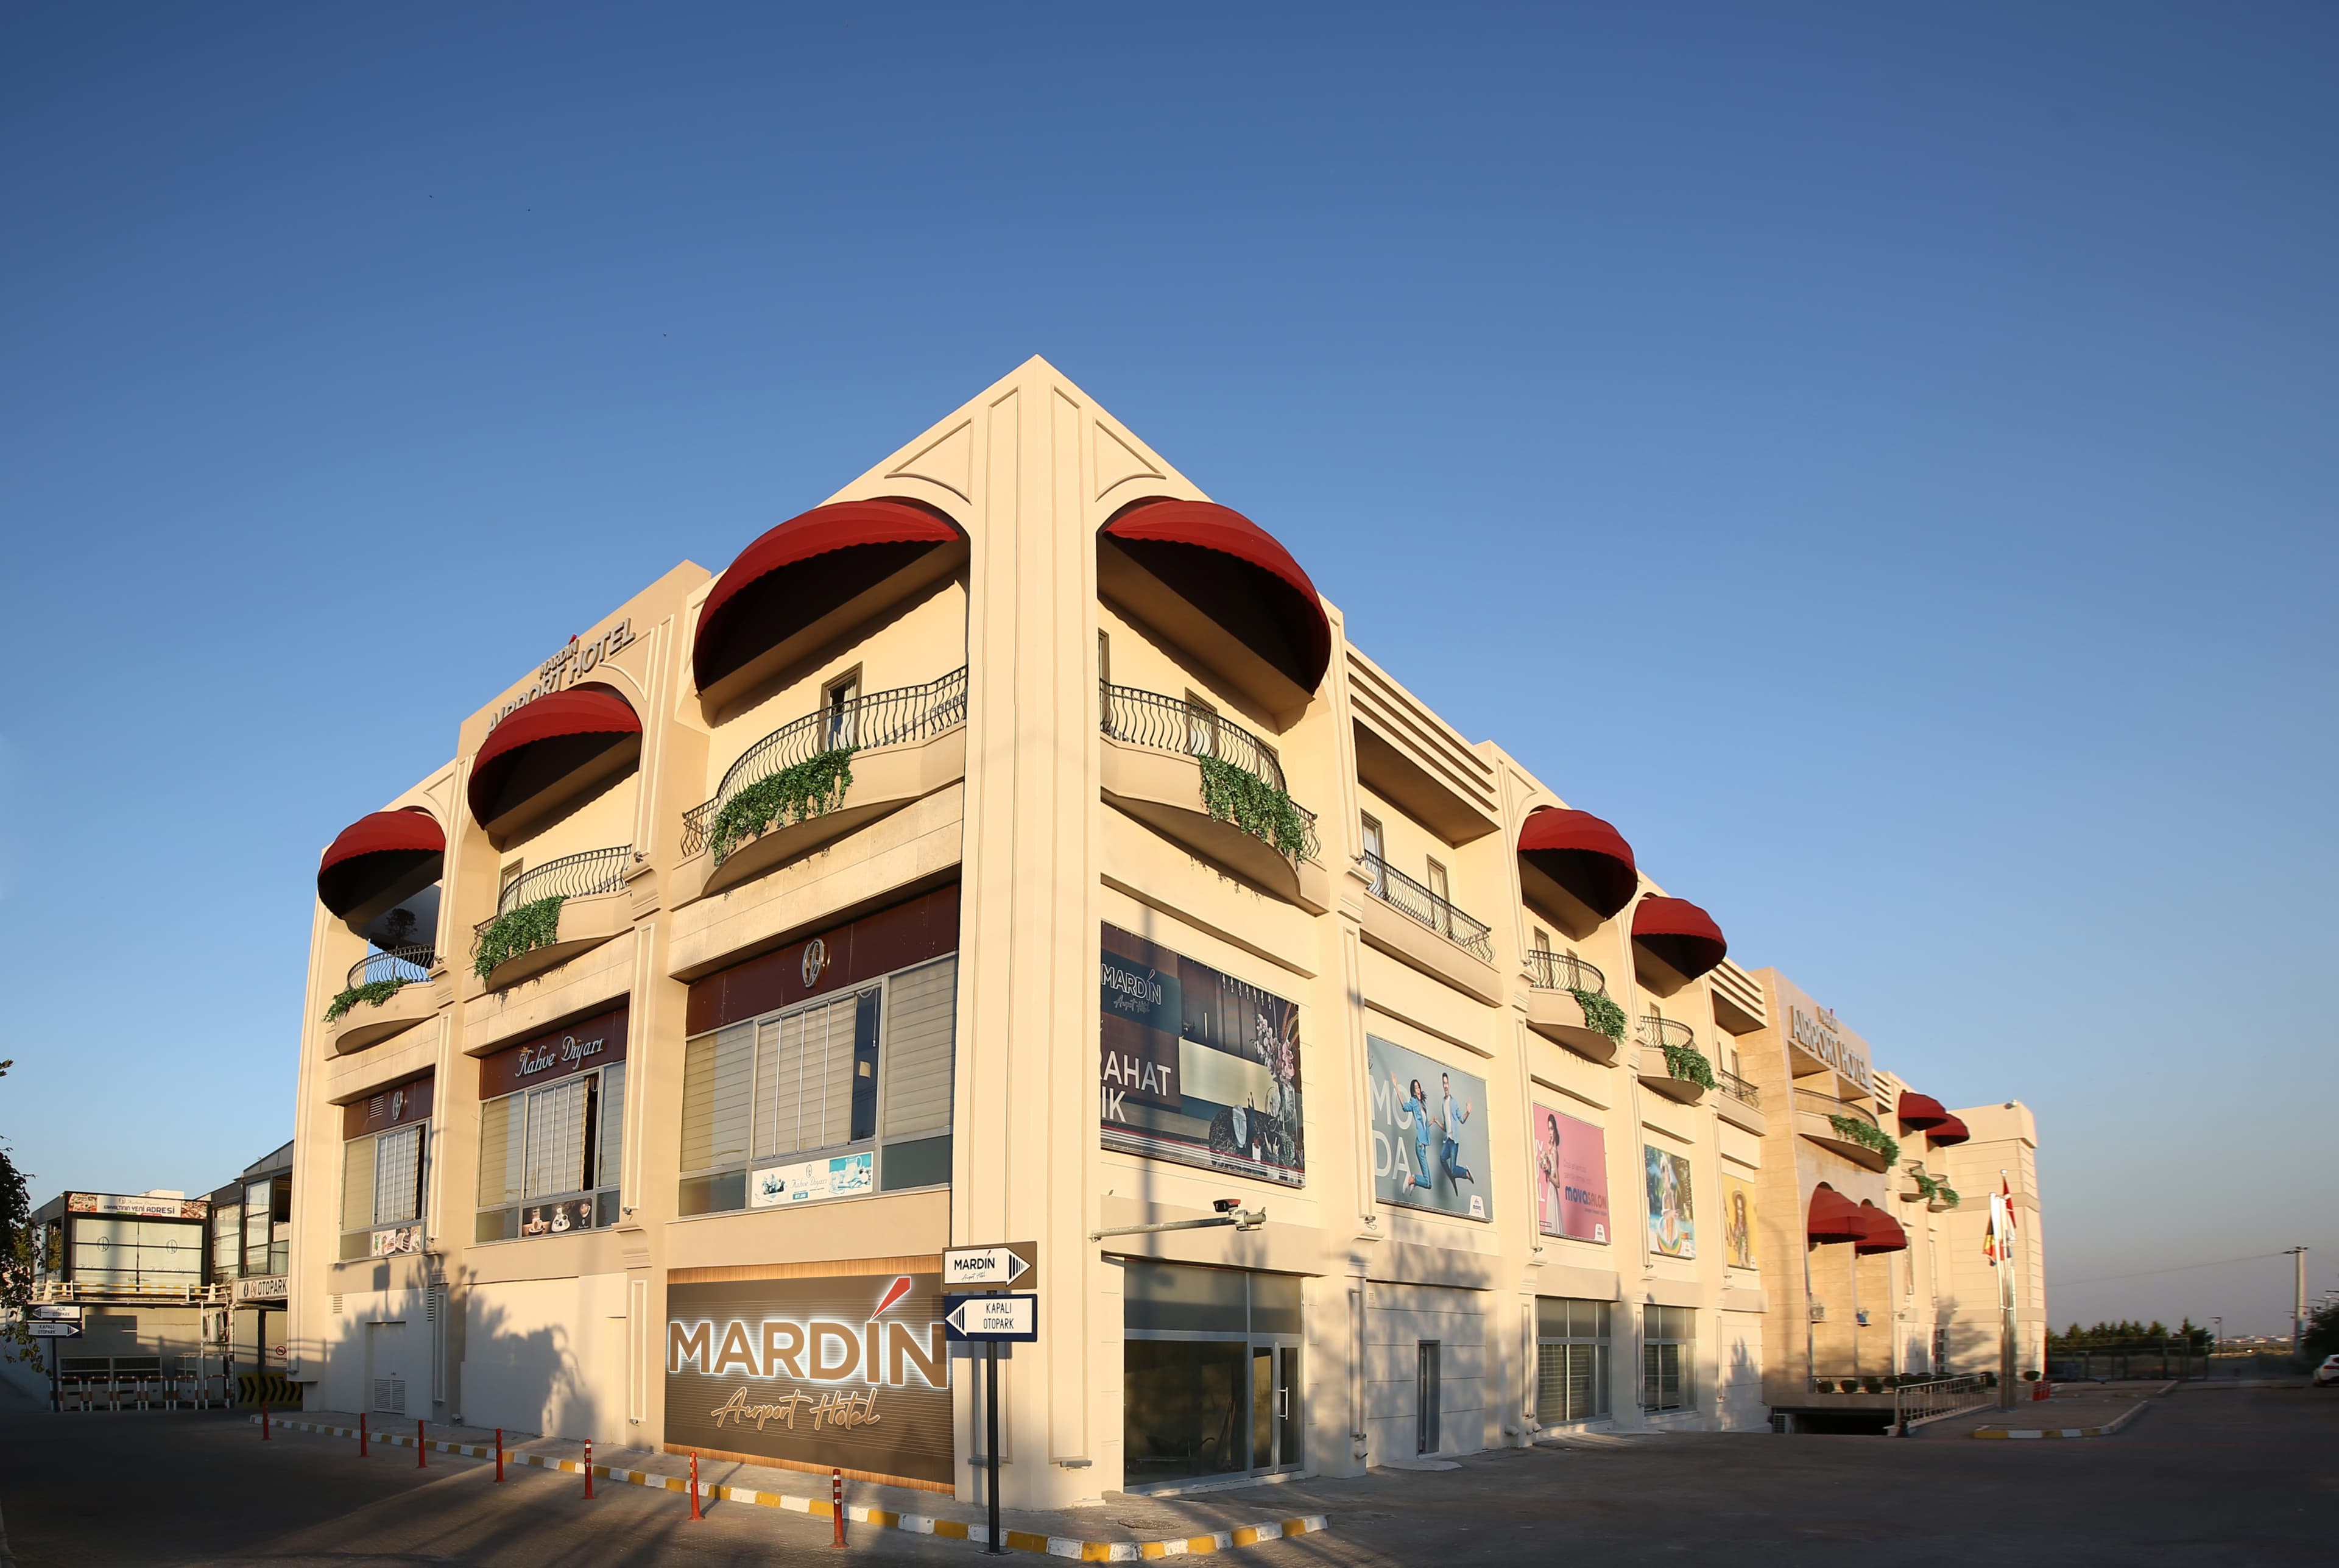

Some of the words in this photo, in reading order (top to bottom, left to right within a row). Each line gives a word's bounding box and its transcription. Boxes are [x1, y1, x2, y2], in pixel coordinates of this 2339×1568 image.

[569, 618, 635, 685] HOTEL
[515, 1045, 557, 1077] Kahve
[1789, 1005, 1839, 1068] AIRPORT
[1837, 1040, 1871, 1089] HOTEL
[1101, 1050, 1171, 1097] AHAT
[258, 1279, 288, 1296] OTOPARK
[983, 1318, 1014, 1329] OTOPARK
[986, 1302, 1012, 1313] KAPALI
[711, 1386, 813, 1431] Airport
[810, 1387, 881, 1430] Hotel
